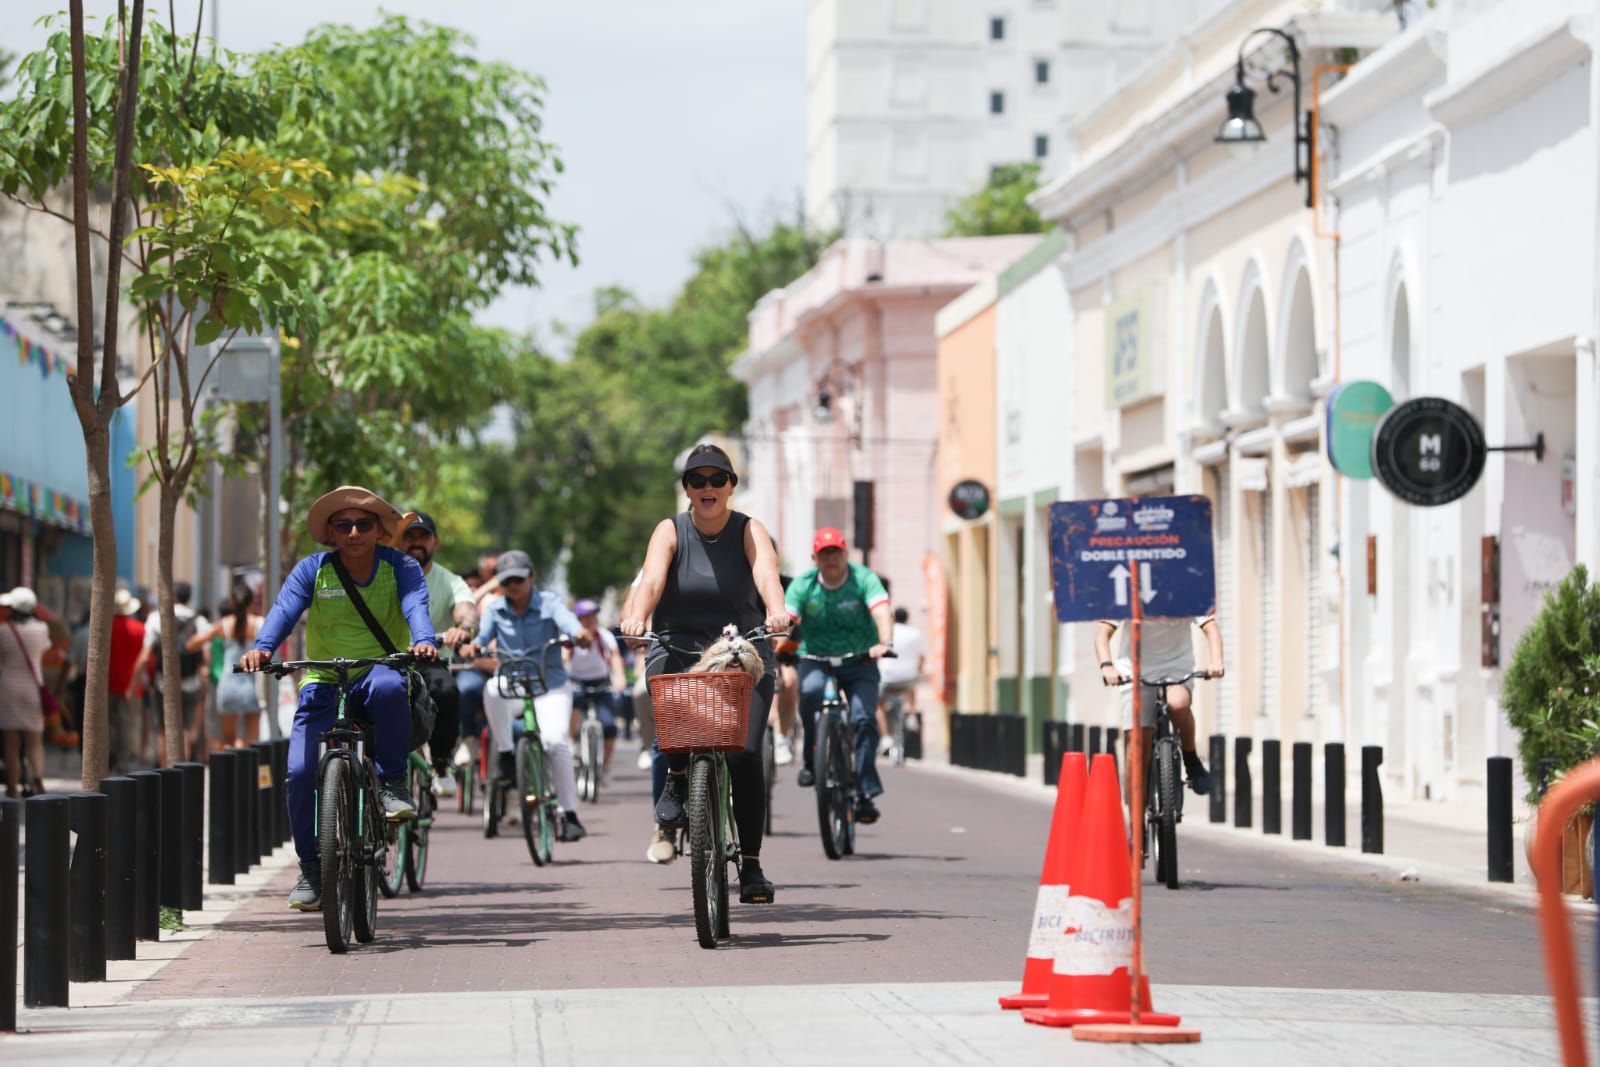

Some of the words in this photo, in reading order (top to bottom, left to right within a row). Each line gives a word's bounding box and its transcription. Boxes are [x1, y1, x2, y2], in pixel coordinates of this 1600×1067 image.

[1419, 434, 1441, 455] M
[1089, 534, 1180, 546] PRECAUCIÓN
[1081, 549, 1125, 562] DOBLE
[1127, 547, 1187, 560] SENTIDO
